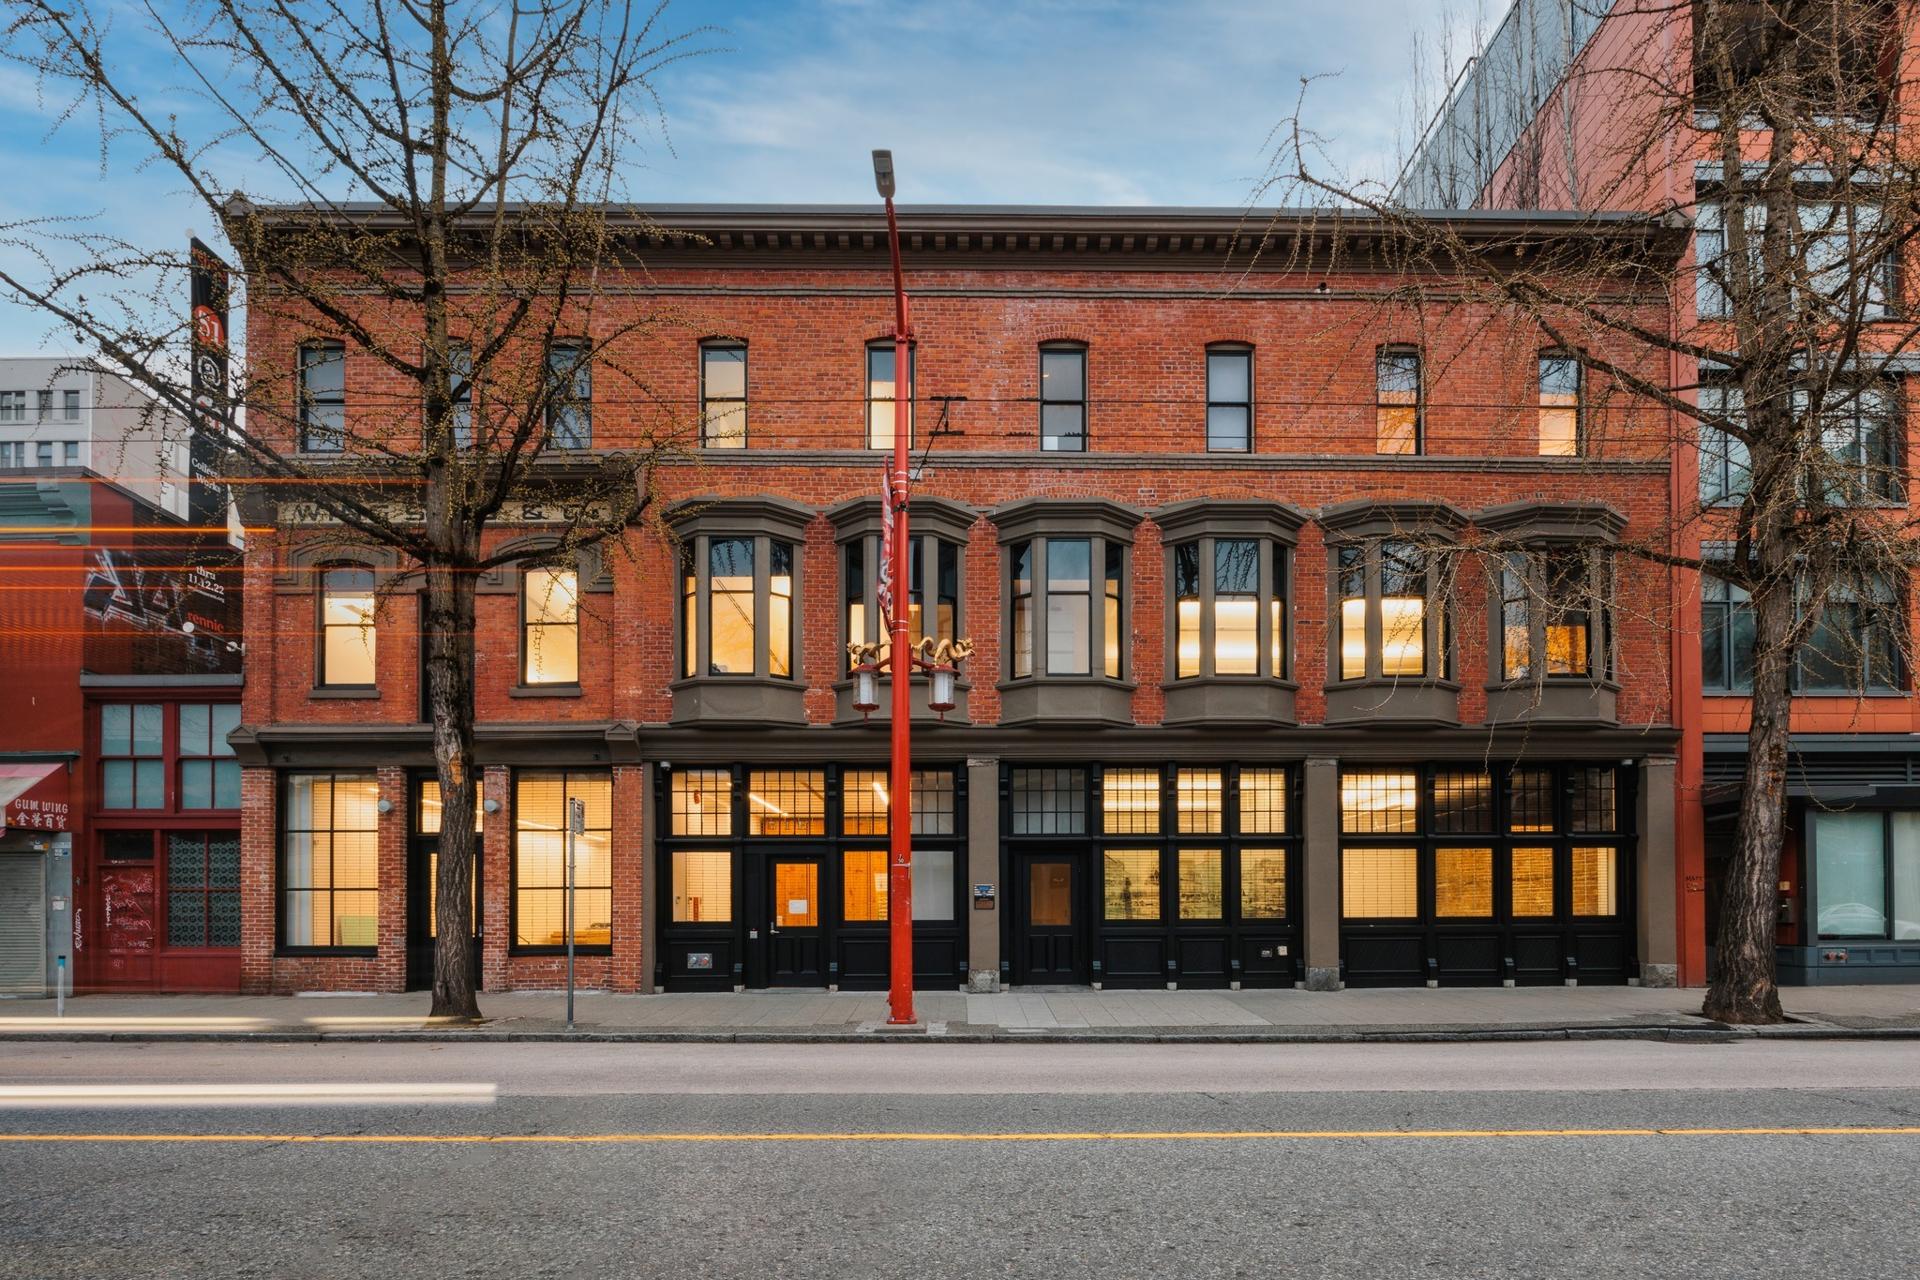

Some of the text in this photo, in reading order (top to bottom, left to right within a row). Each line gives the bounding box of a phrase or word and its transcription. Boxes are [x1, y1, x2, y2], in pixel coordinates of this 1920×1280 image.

[196, 565, 216, 580] thru
[187, 612, 225, 633] rennie
[15, 798, 69, 815] GUM WING
